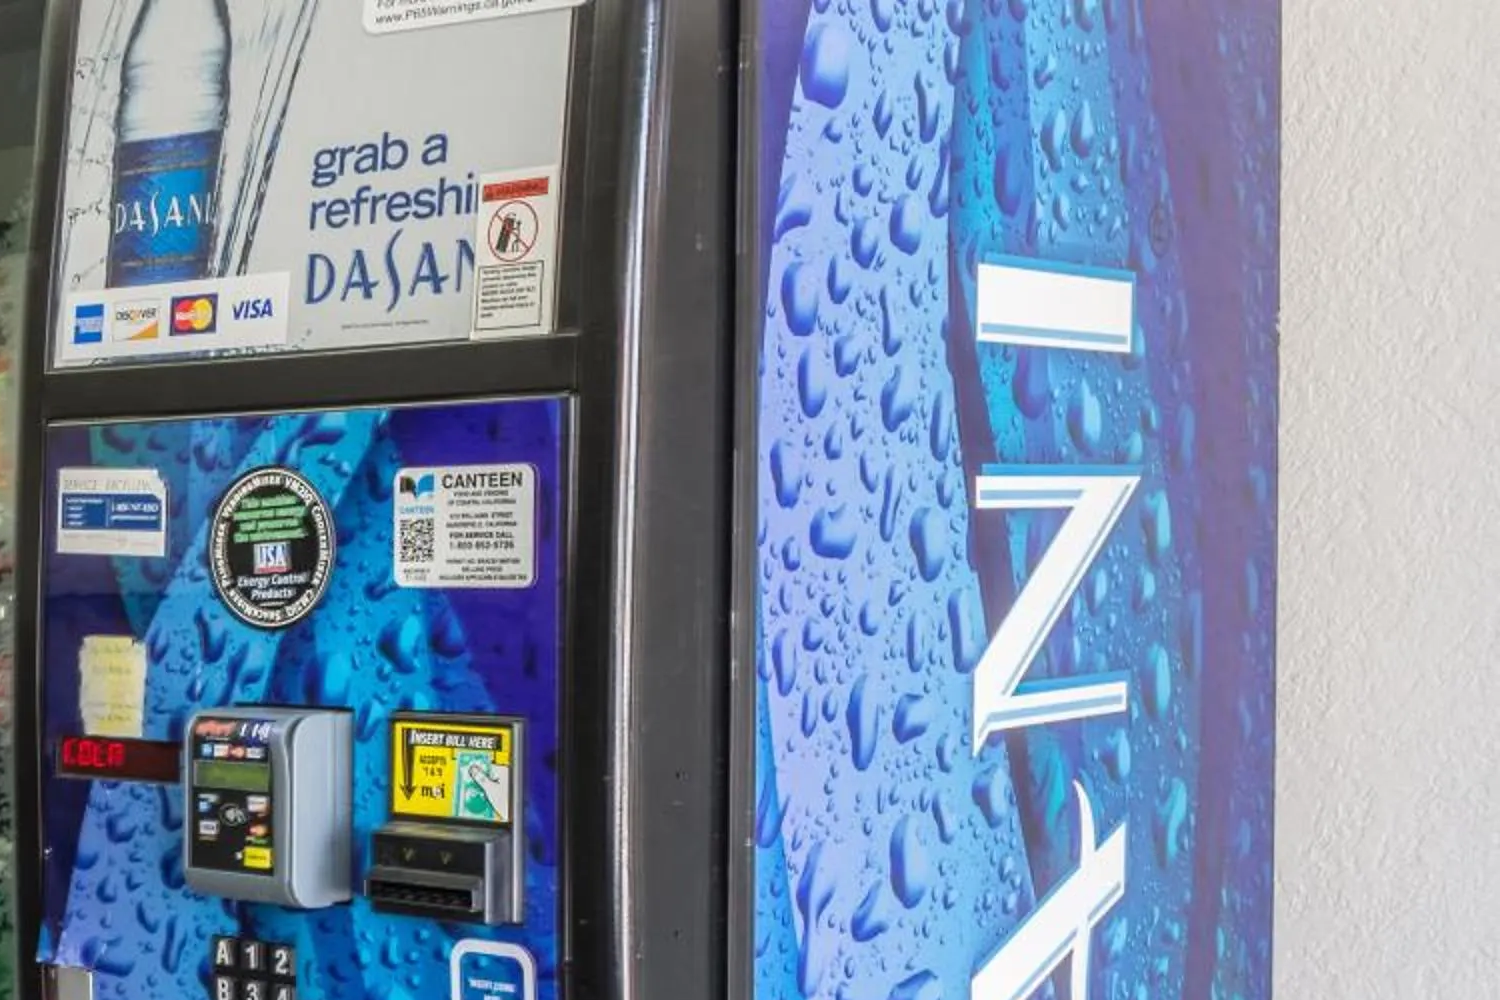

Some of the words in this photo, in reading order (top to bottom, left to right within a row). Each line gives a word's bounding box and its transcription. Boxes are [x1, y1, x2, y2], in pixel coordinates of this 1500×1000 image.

[311, 131, 409, 188] grab
[421, 133, 448, 166] a
[115, 191, 213, 238] DASANI
[309, 172, 479, 231] refreshi
[305, 228, 475, 313] DASAN
[232, 298, 273, 321] VISA
[441, 471, 523, 489] CANTEEN
[237, 575, 270, 588] Energy
[252, 587, 293, 600] Products
[410, 730, 444, 745] INSERT
[445, 733, 466, 746] BILL
[468, 735, 497, 749] HERE
[216, 940, 230, 965] A
[245, 945, 256, 970] 1
[275, 949, 288, 974] 2
